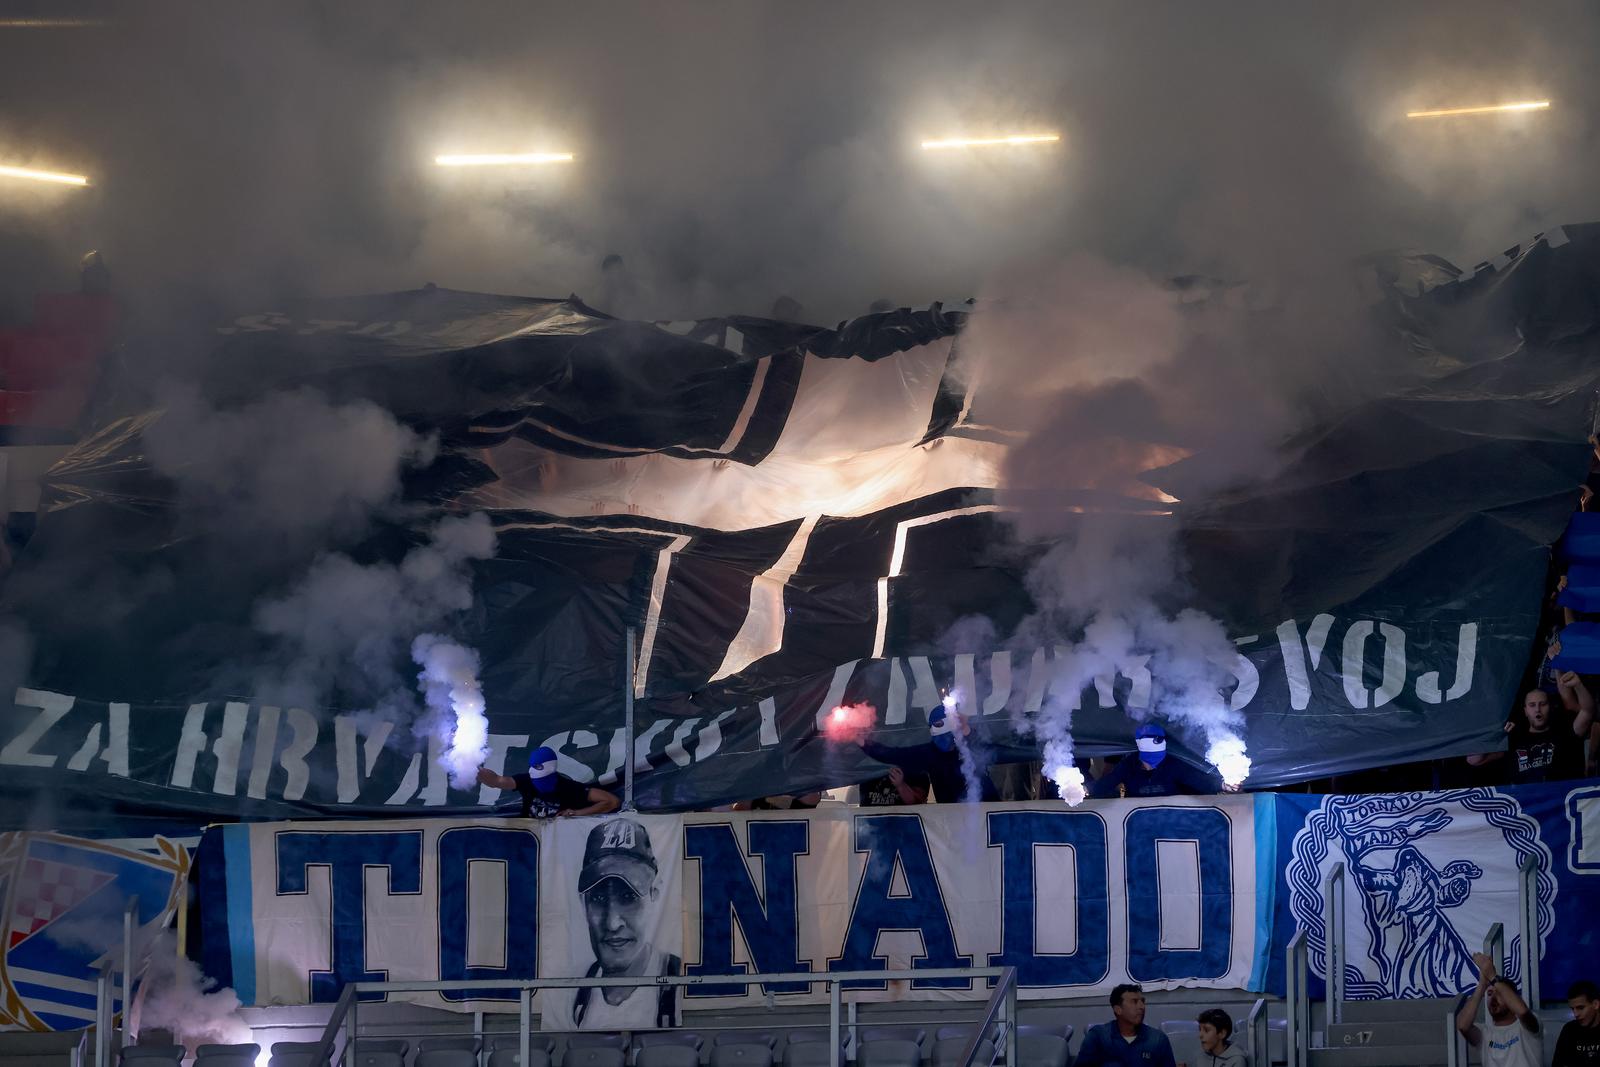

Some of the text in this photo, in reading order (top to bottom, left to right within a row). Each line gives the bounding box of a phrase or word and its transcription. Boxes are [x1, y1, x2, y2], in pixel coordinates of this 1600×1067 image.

[1, 687, 130, 777] ZA
[758, 696, 779, 746] I
[1347, 792, 1423, 823] TORNADO
[1356, 827, 1408, 850] ZADAR
